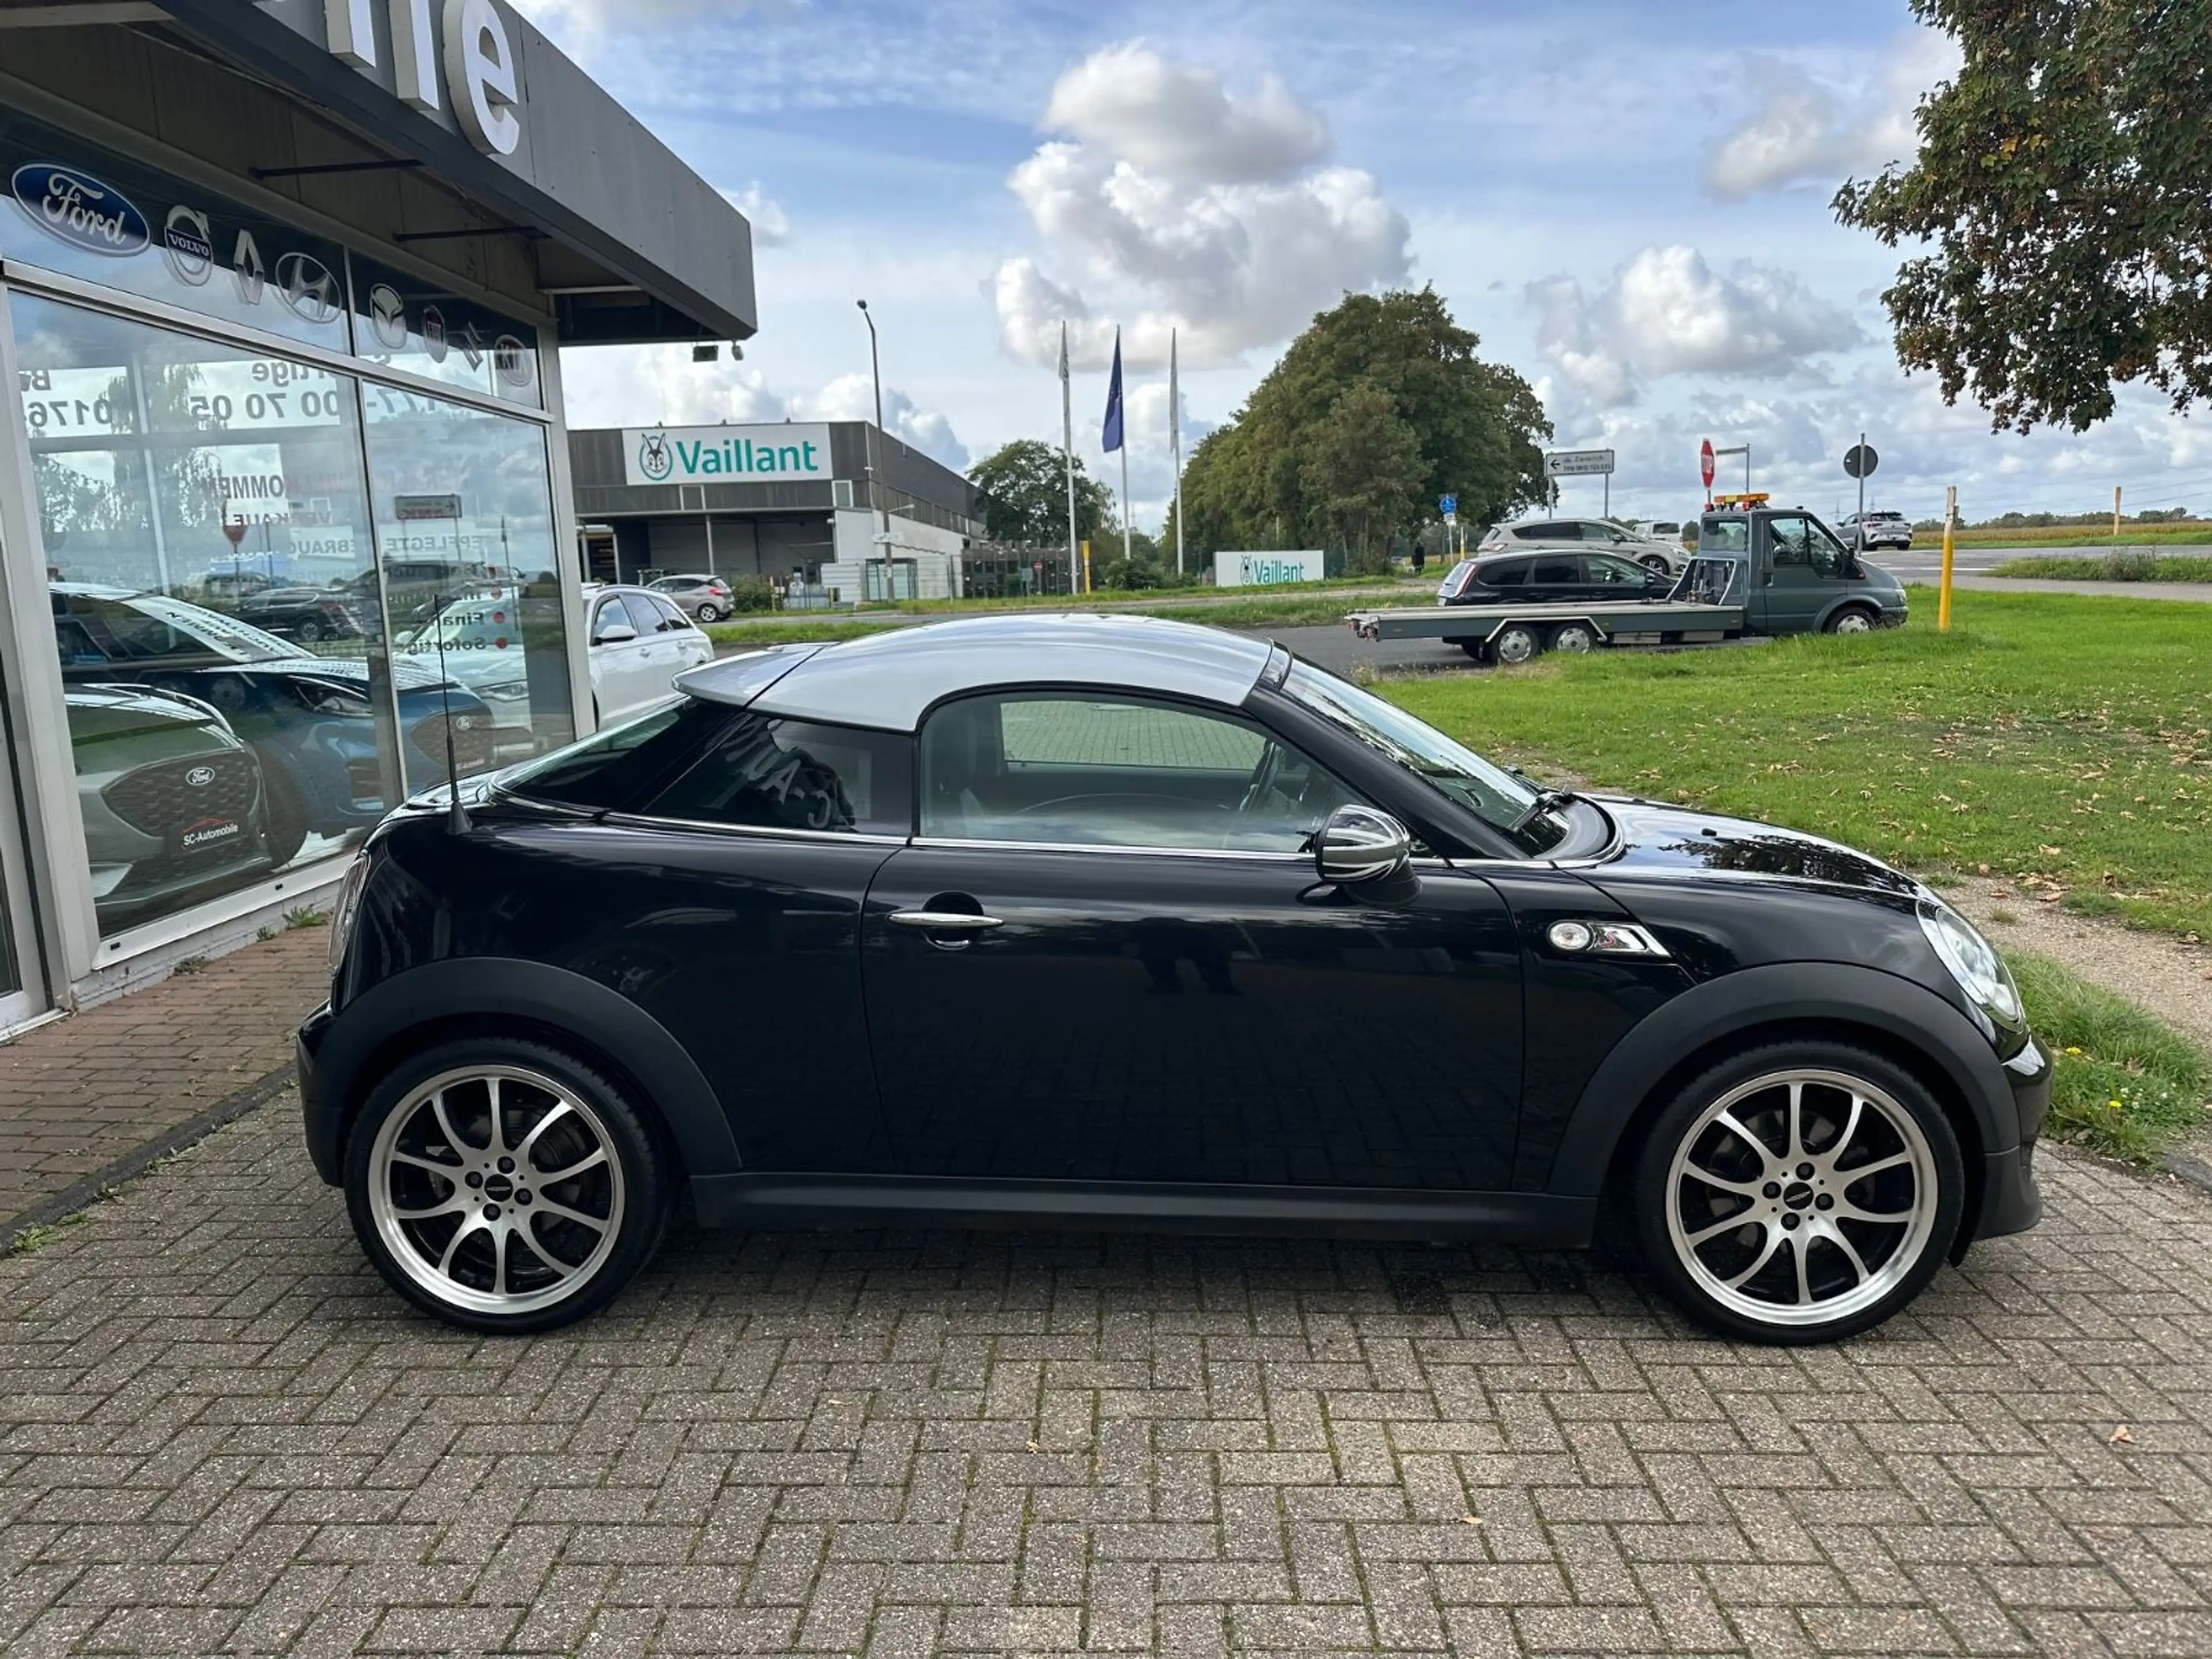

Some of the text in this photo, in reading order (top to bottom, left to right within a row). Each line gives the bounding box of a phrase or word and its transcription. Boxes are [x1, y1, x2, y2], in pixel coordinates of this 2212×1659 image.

[43, 173, 126, 245] Ford
[169, 233, 210, 257] VOLVO
[675, 438, 819, 474] Vaillant
[1254, 559, 1304, 583] Vaillant
[183, 823, 239, 846] SC-Automobile
